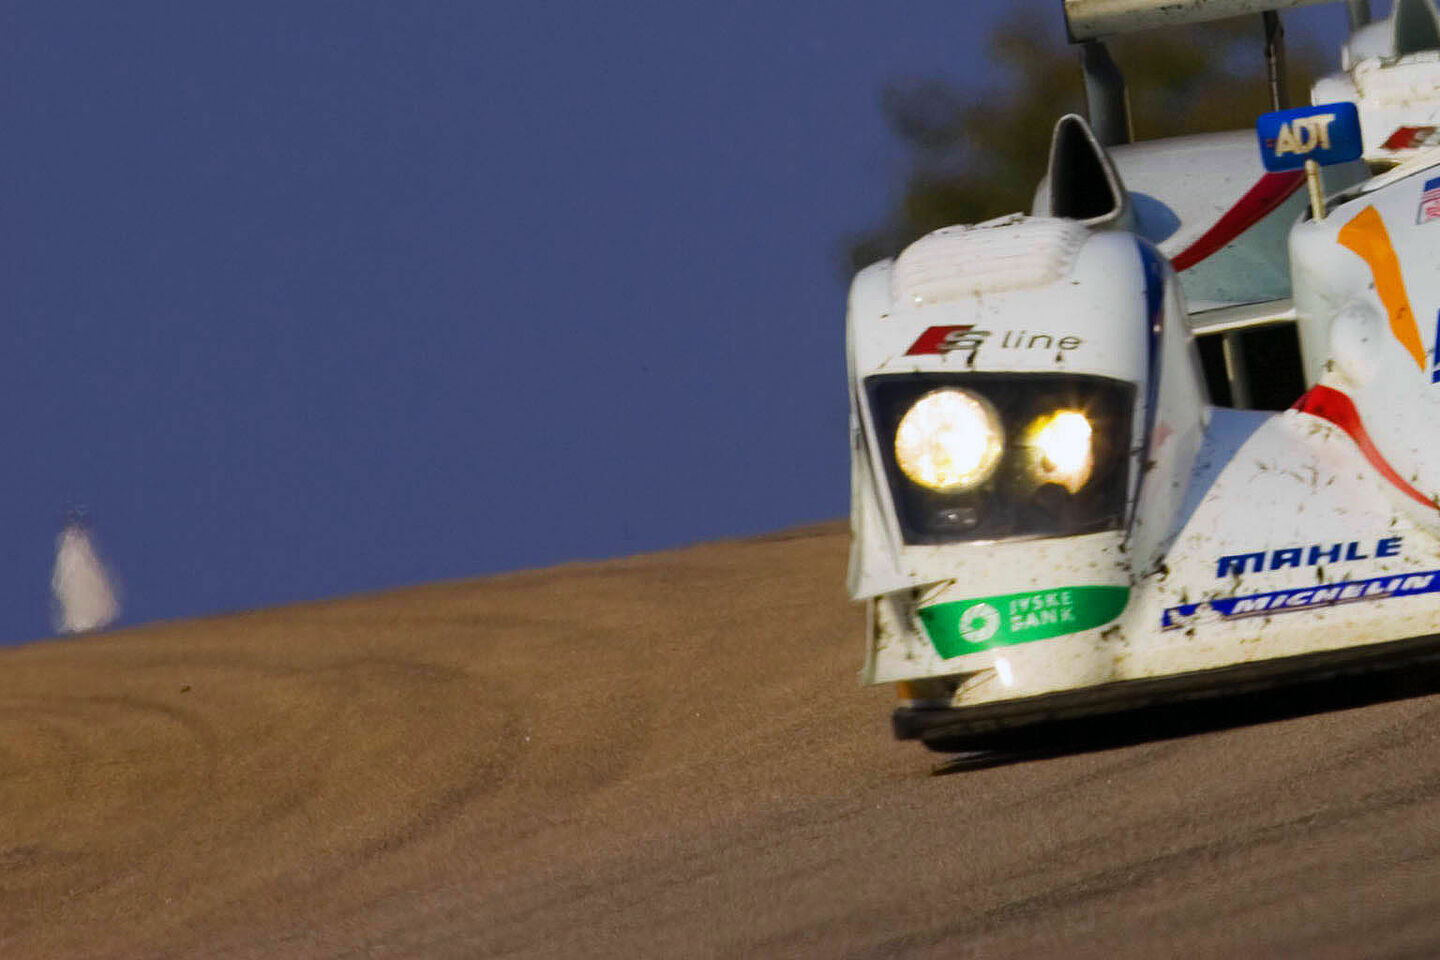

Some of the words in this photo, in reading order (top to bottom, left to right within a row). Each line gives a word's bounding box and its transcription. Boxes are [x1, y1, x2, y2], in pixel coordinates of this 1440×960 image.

[1275, 113, 1336, 157] ADT
[1001, 329, 1082, 350] line
[1216, 536, 1402, 578] MAHLE
[1230, 574, 1437, 616] MICHELIN
